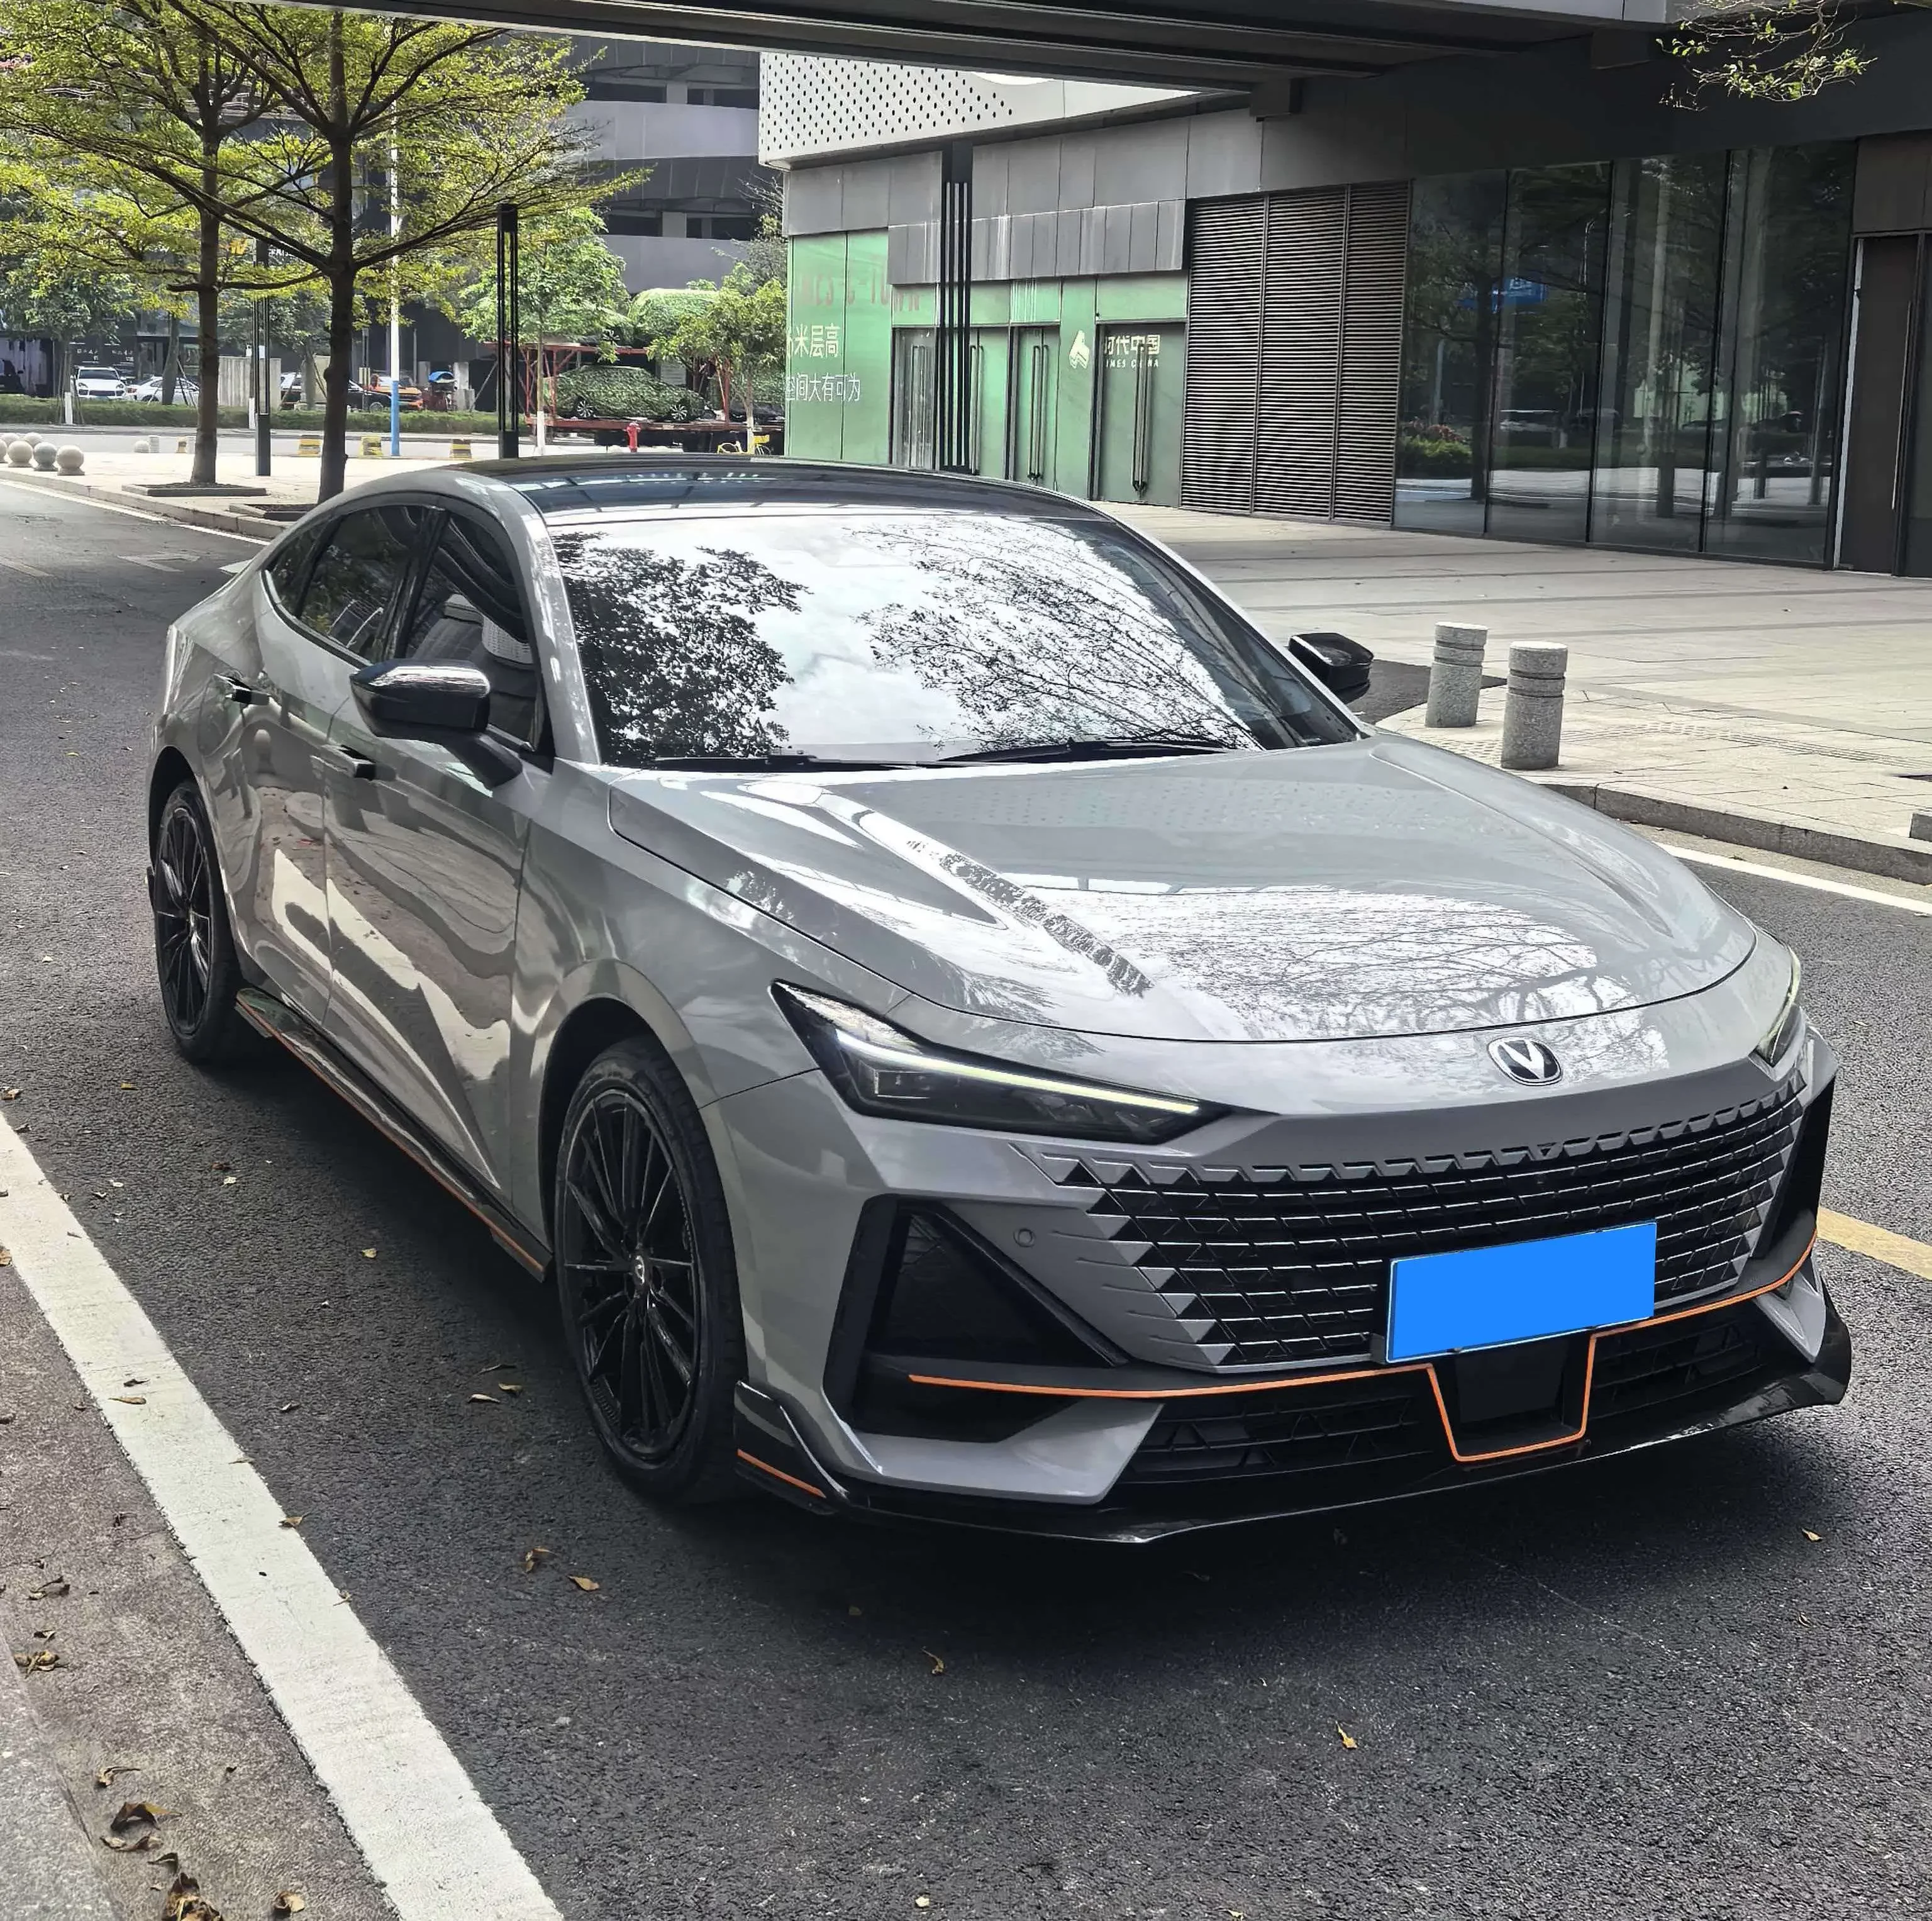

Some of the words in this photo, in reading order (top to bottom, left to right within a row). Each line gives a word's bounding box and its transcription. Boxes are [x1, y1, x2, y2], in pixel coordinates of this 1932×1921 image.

[1106, 359, 1126, 369] IMES
[1131, 358, 1158, 369] CINA
[786, 372, 860, 403] 空间大有可为
